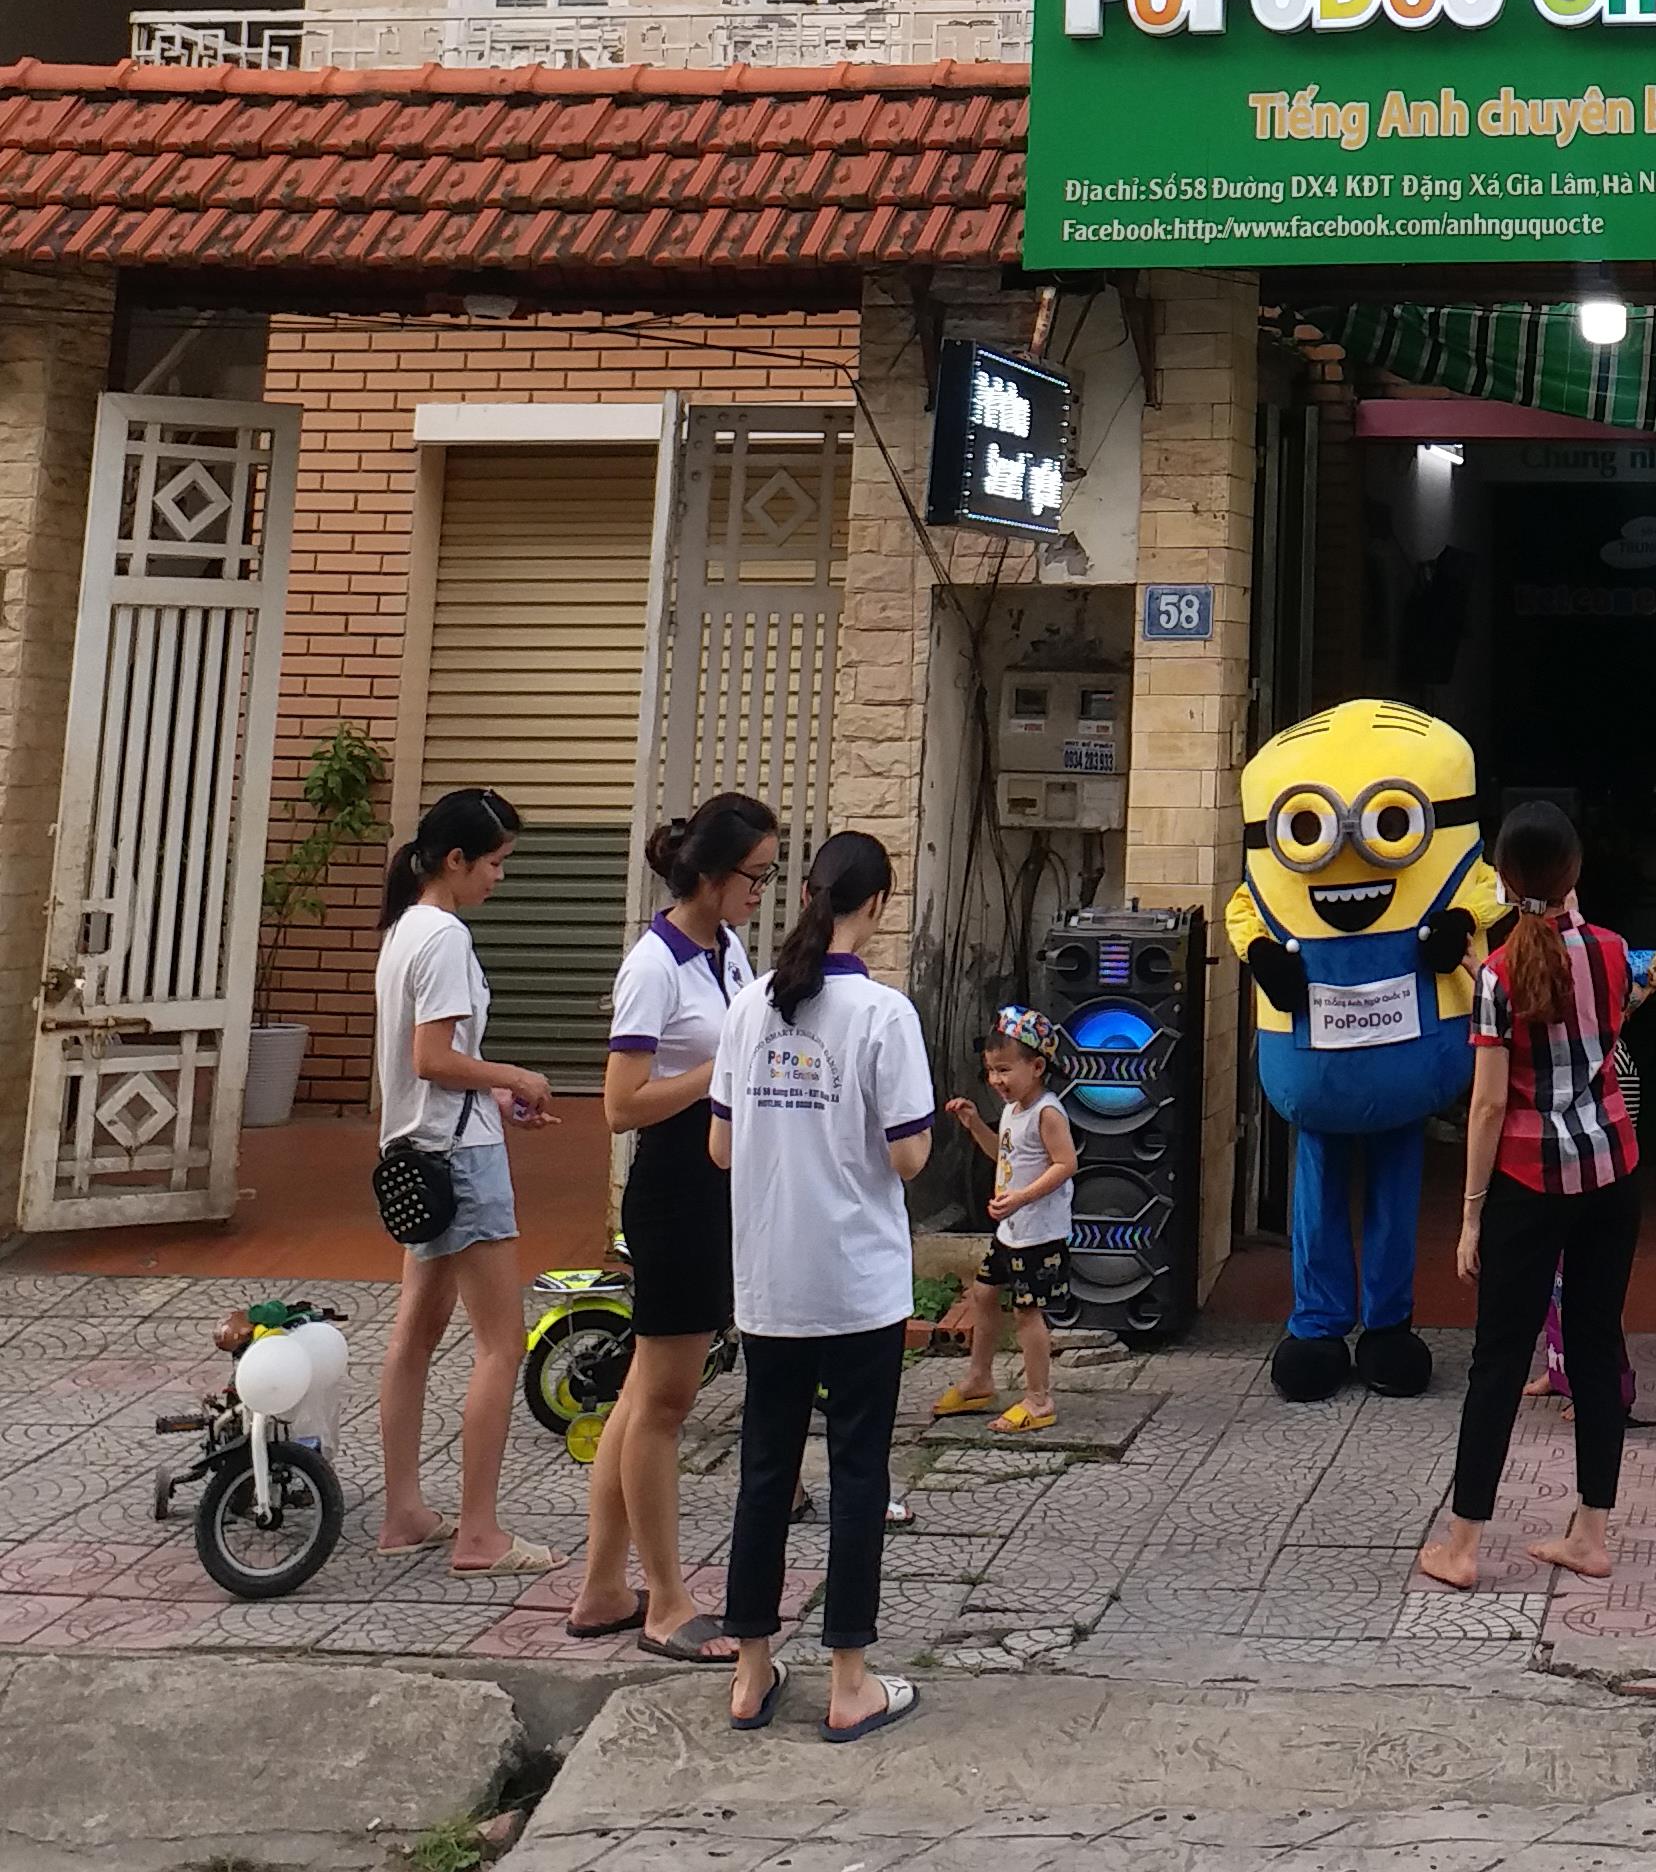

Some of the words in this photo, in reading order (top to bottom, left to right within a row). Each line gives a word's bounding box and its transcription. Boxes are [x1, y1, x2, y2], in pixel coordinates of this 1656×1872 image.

[1248, 81, 1370, 151] Tiếng
[1377, 87, 1468, 140] Anh
[1476, 85, 1633, 149] chuyên
[1212, 175, 1286, 203] Đường
[1291, 174, 1339, 199] DX4
[1346, 174, 1394, 197] KĐT
[1402, 175, 1463, 201] Đặng
[1506, 174, 1545, 196] Gia
[1602, 173, 1634, 195] Hà
[1158, 593, 1201, 630] 58
[1323, 1011, 1403, 1030] PoPoDoo
